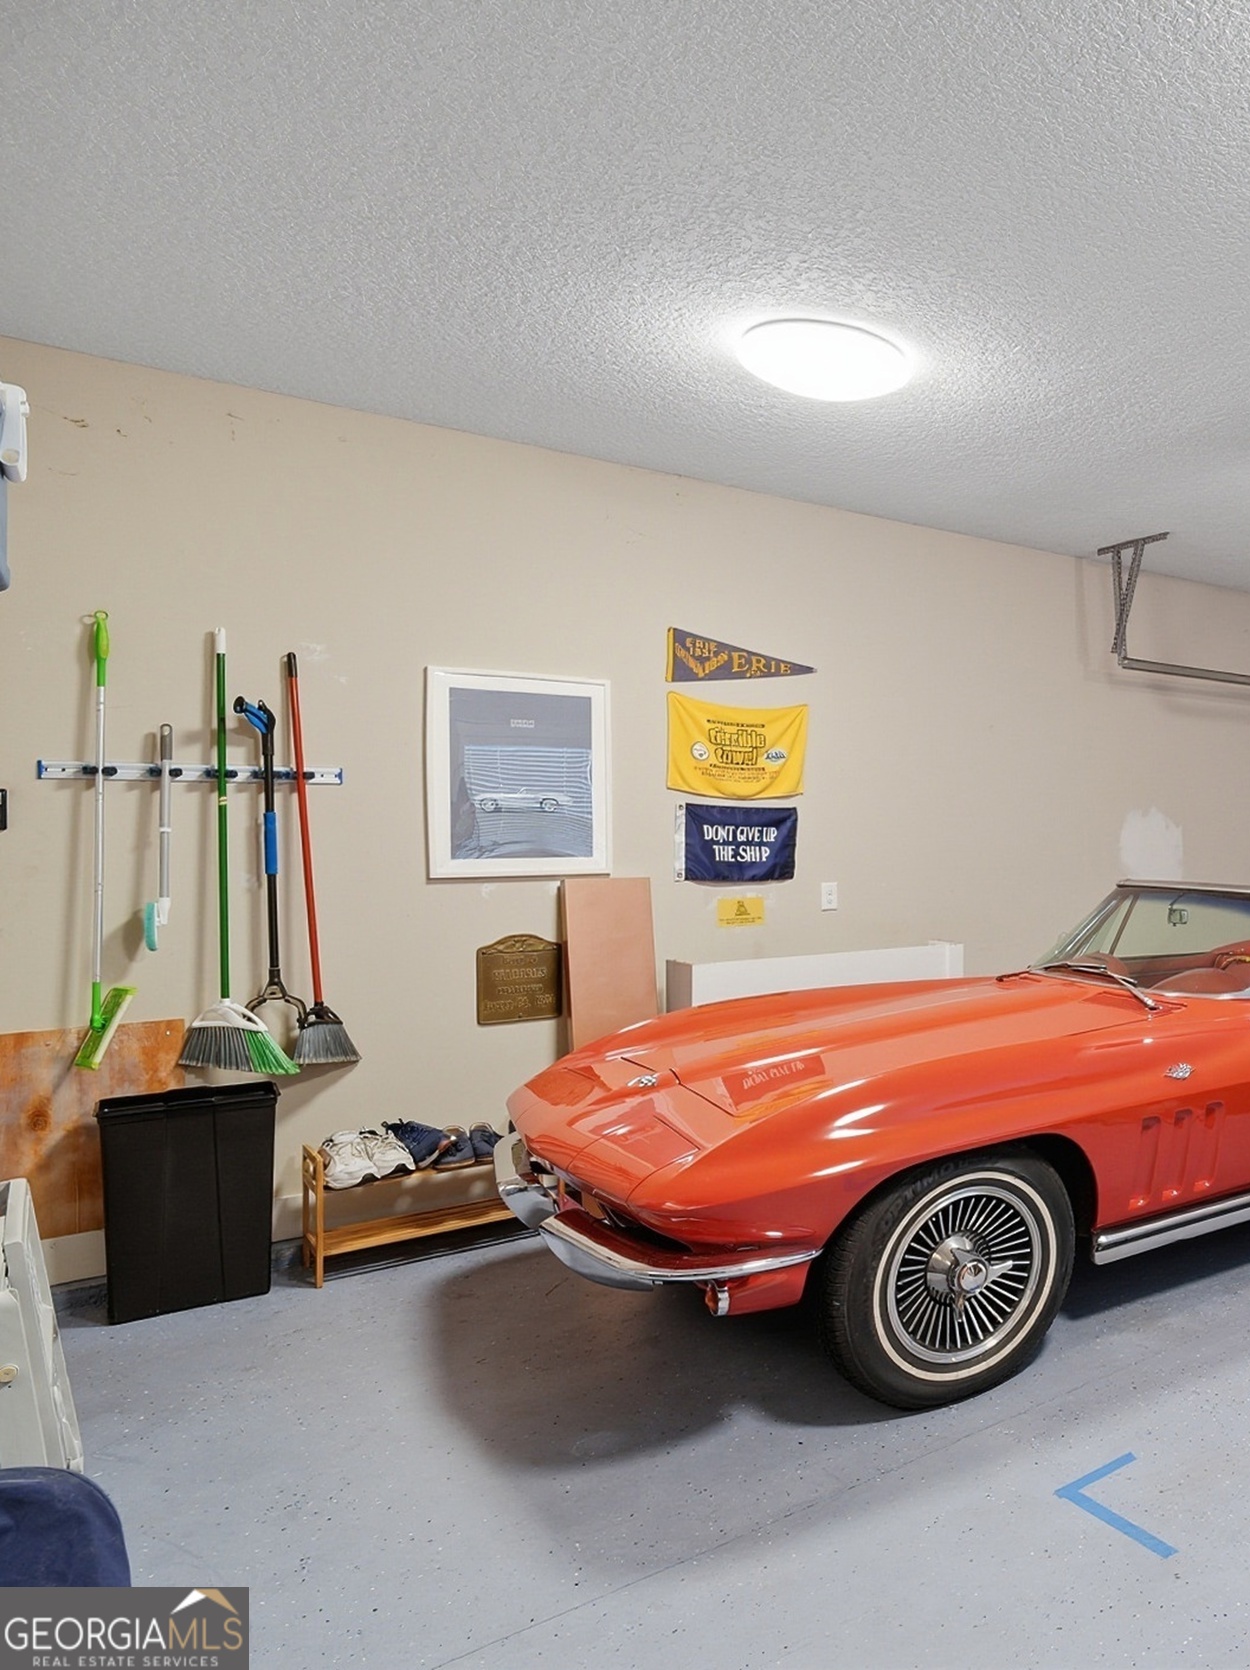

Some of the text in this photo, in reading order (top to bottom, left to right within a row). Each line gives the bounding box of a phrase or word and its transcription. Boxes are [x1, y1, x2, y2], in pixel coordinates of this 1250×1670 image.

[731, 651, 791, 674] ERIE
[737, 826, 762, 842] GIVE
[763, 827, 778, 842] UP
[712, 845, 770, 862] THE SHIP
